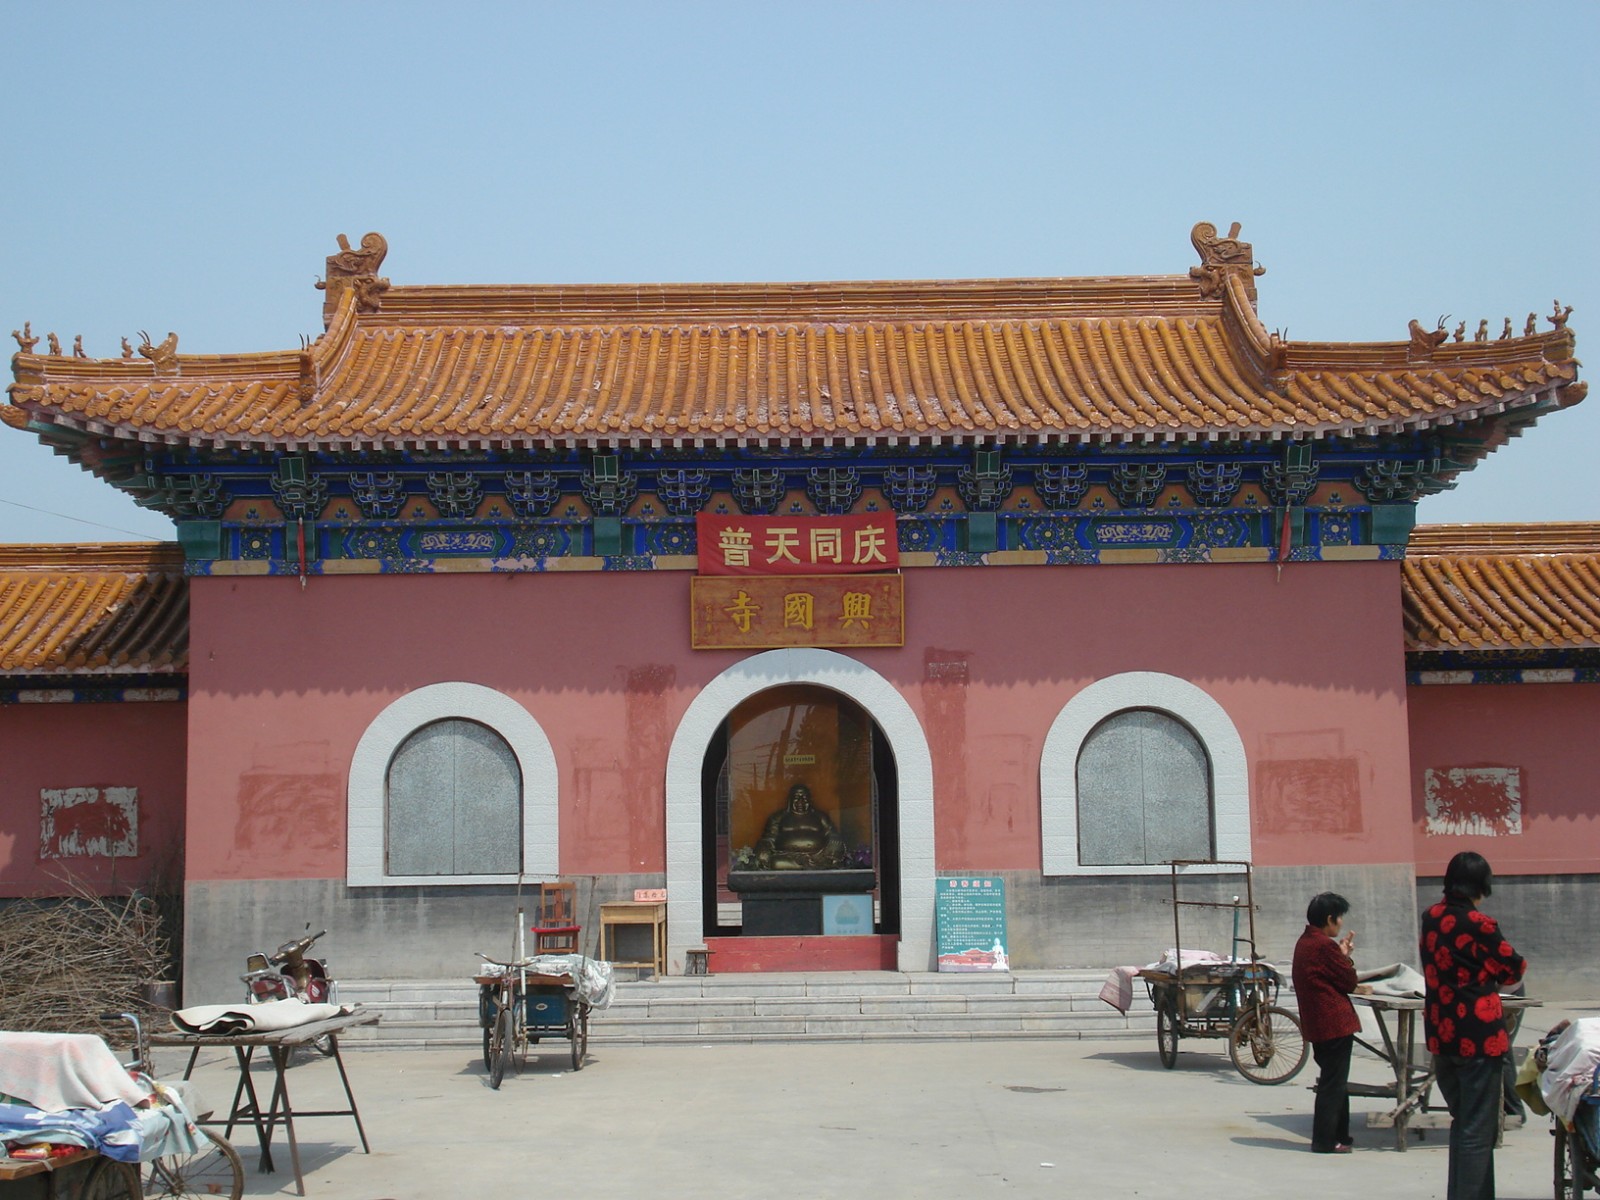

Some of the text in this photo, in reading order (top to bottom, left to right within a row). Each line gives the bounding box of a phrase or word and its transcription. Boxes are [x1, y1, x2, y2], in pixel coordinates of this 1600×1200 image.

[718, 524, 887, 567] 普天同庆
[724, 590, 874, 633] 興國寺
